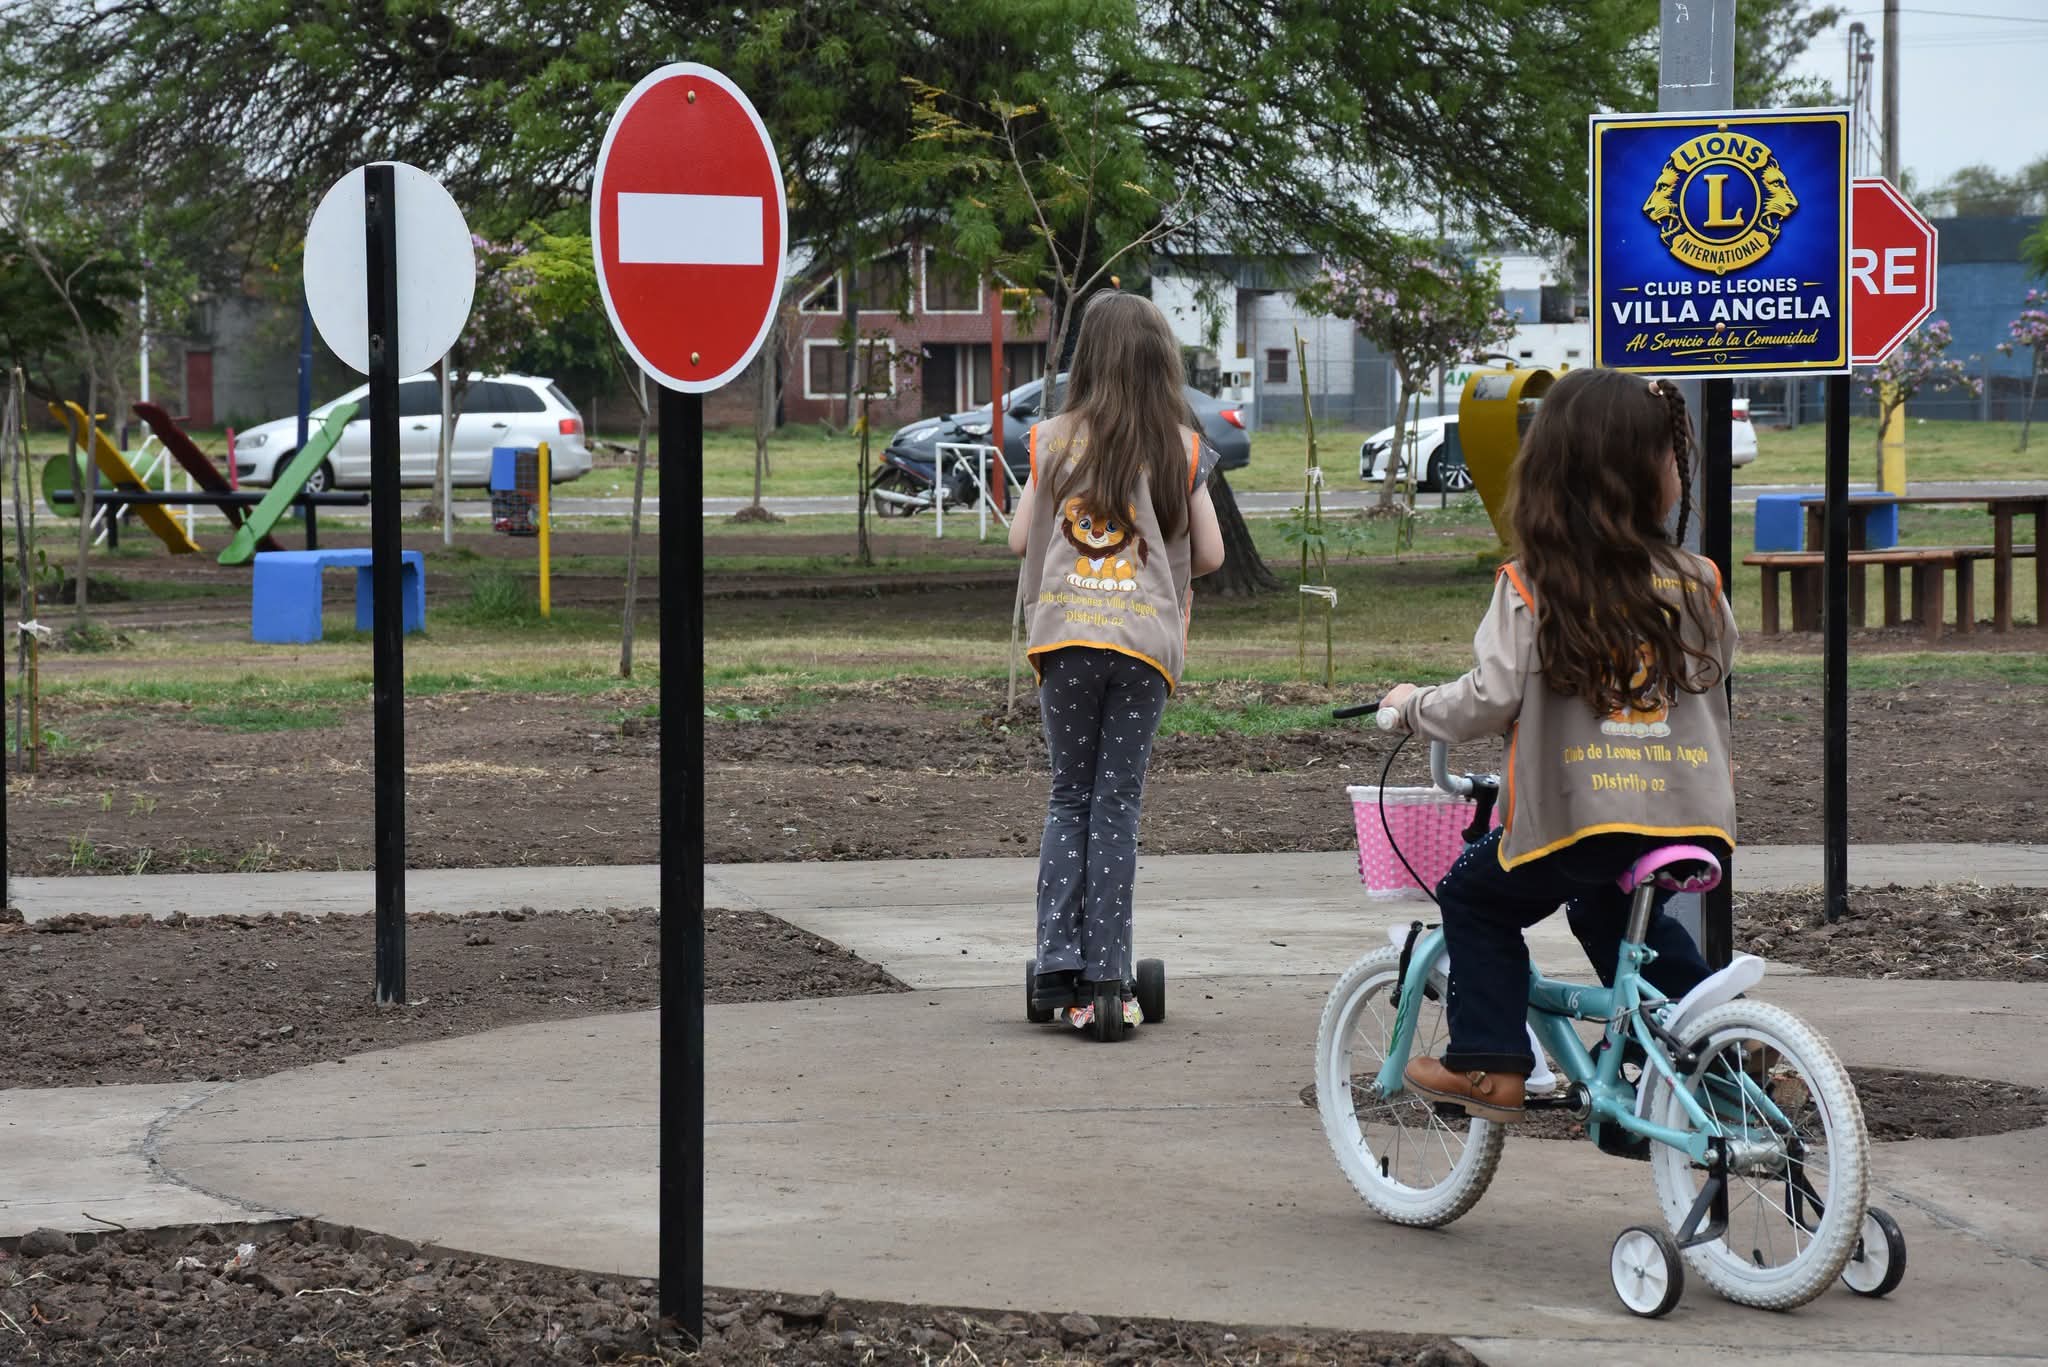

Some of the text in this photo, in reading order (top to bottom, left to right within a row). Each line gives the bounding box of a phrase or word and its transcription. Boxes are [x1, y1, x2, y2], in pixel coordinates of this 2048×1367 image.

[1680, 137, 1763, 166] LIONS
[1703, 174, 1745, 227] L
[1677, 236, 1765, 264] INTERNATIONAL
[1644, 278, 1798, 296] CLUB DE LEONES
[1611, 295, 1831, 325] VILLA ANGELA
[1625, 328, 1819, 352] Al Servicio de la Comunidad
[1587, 744, 1602, 760] de
[1606, 744, 1642, 761] Leones
[1644, 745, 1672, 762] Villa
[1592, 772, 1666, 792] Distrito 02
[1568, 991, 1581, 1009] 16
